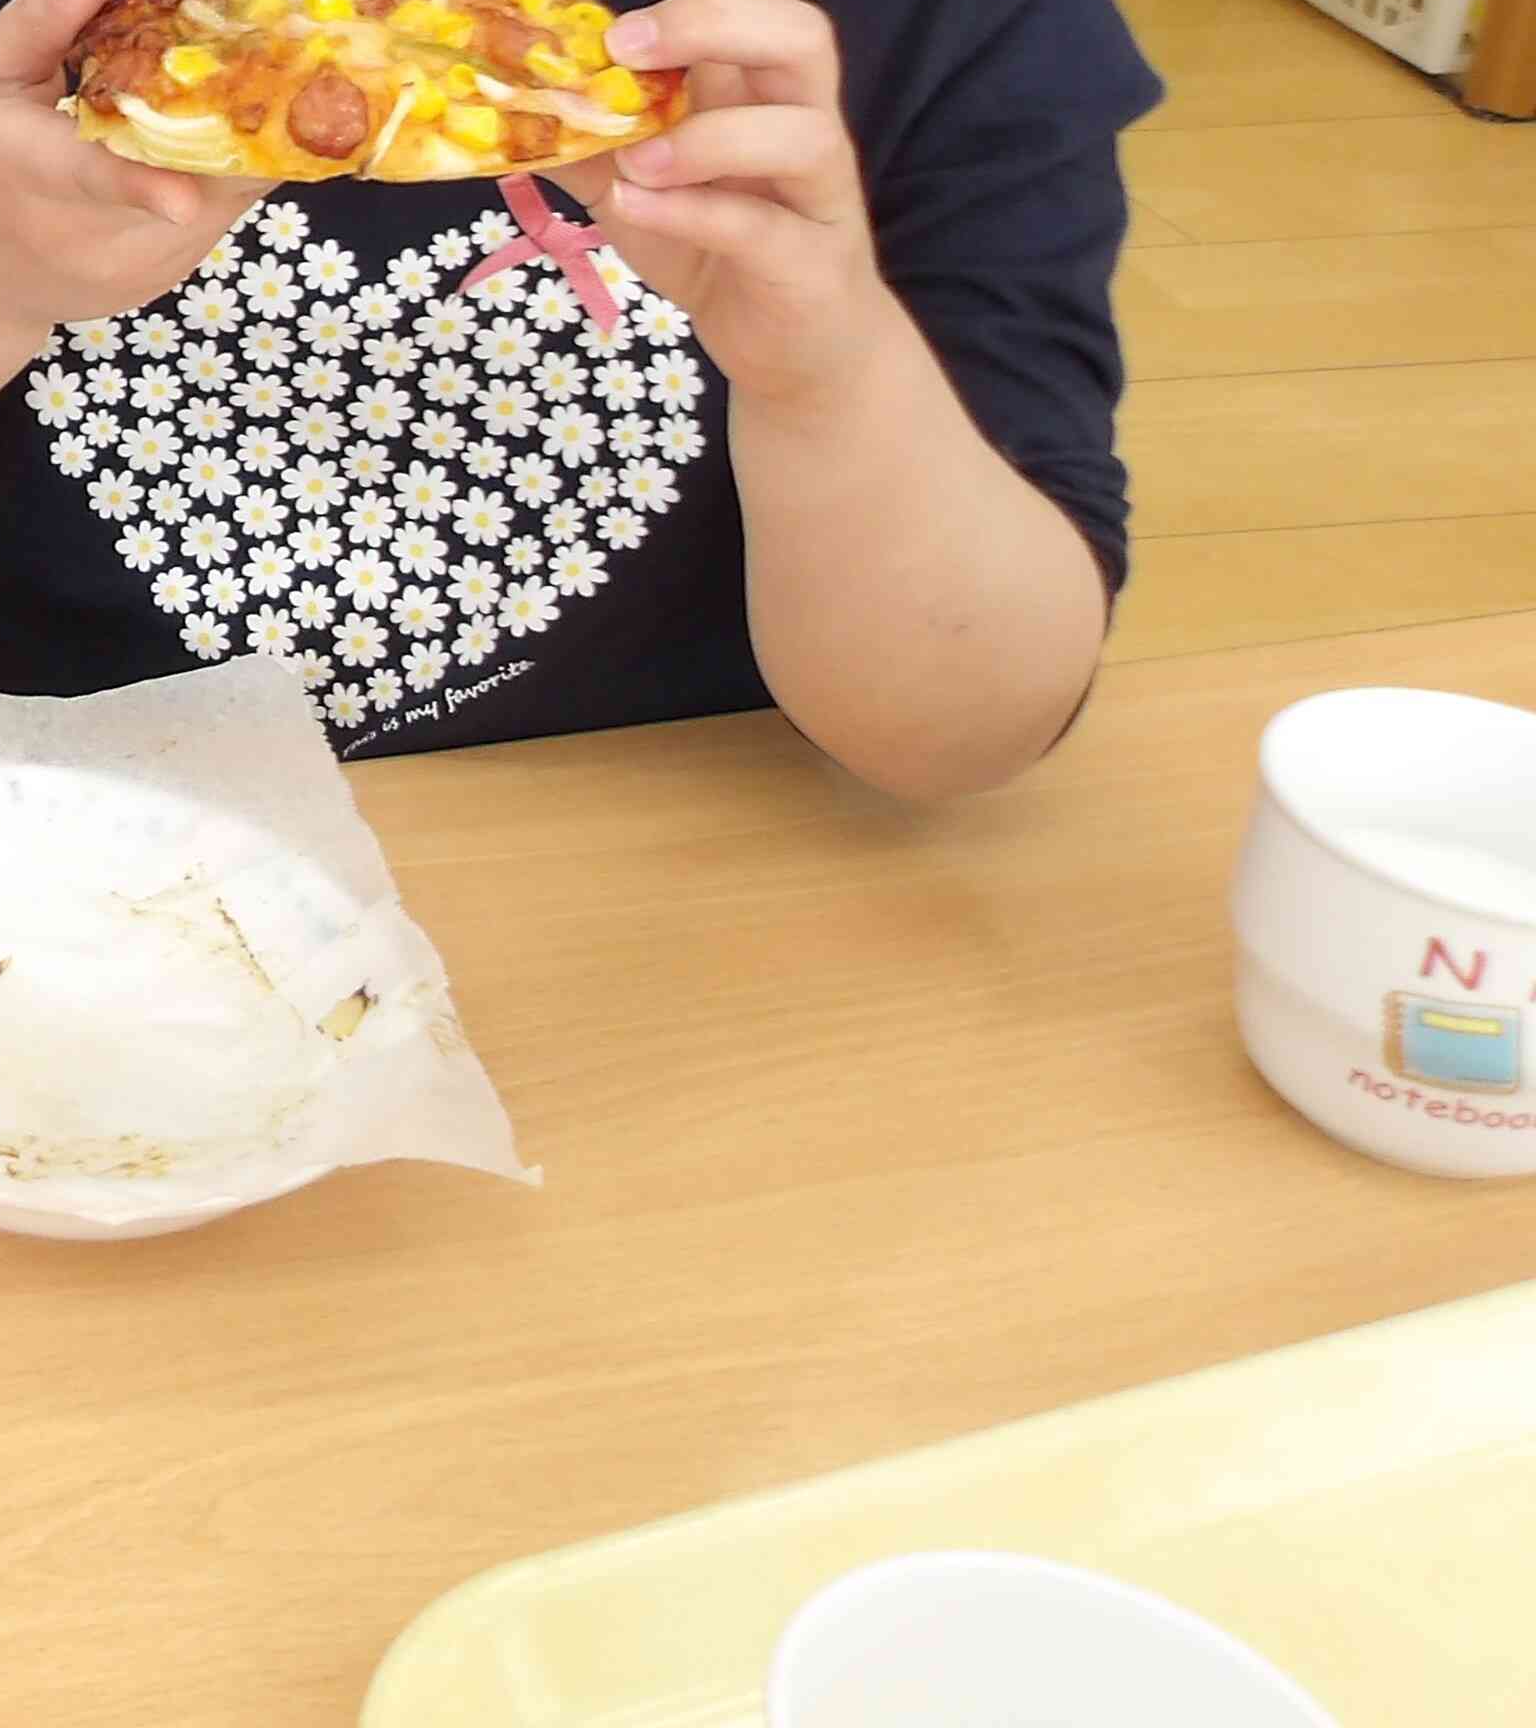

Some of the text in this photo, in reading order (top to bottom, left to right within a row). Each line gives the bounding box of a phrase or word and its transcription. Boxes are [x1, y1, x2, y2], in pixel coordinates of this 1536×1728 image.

[382, 715, 399, 732] is
[405, 701, 439, 721] my
[1419, 936, 1488, 990] N
[1348, 1068, 1536, 1129] noteboo
